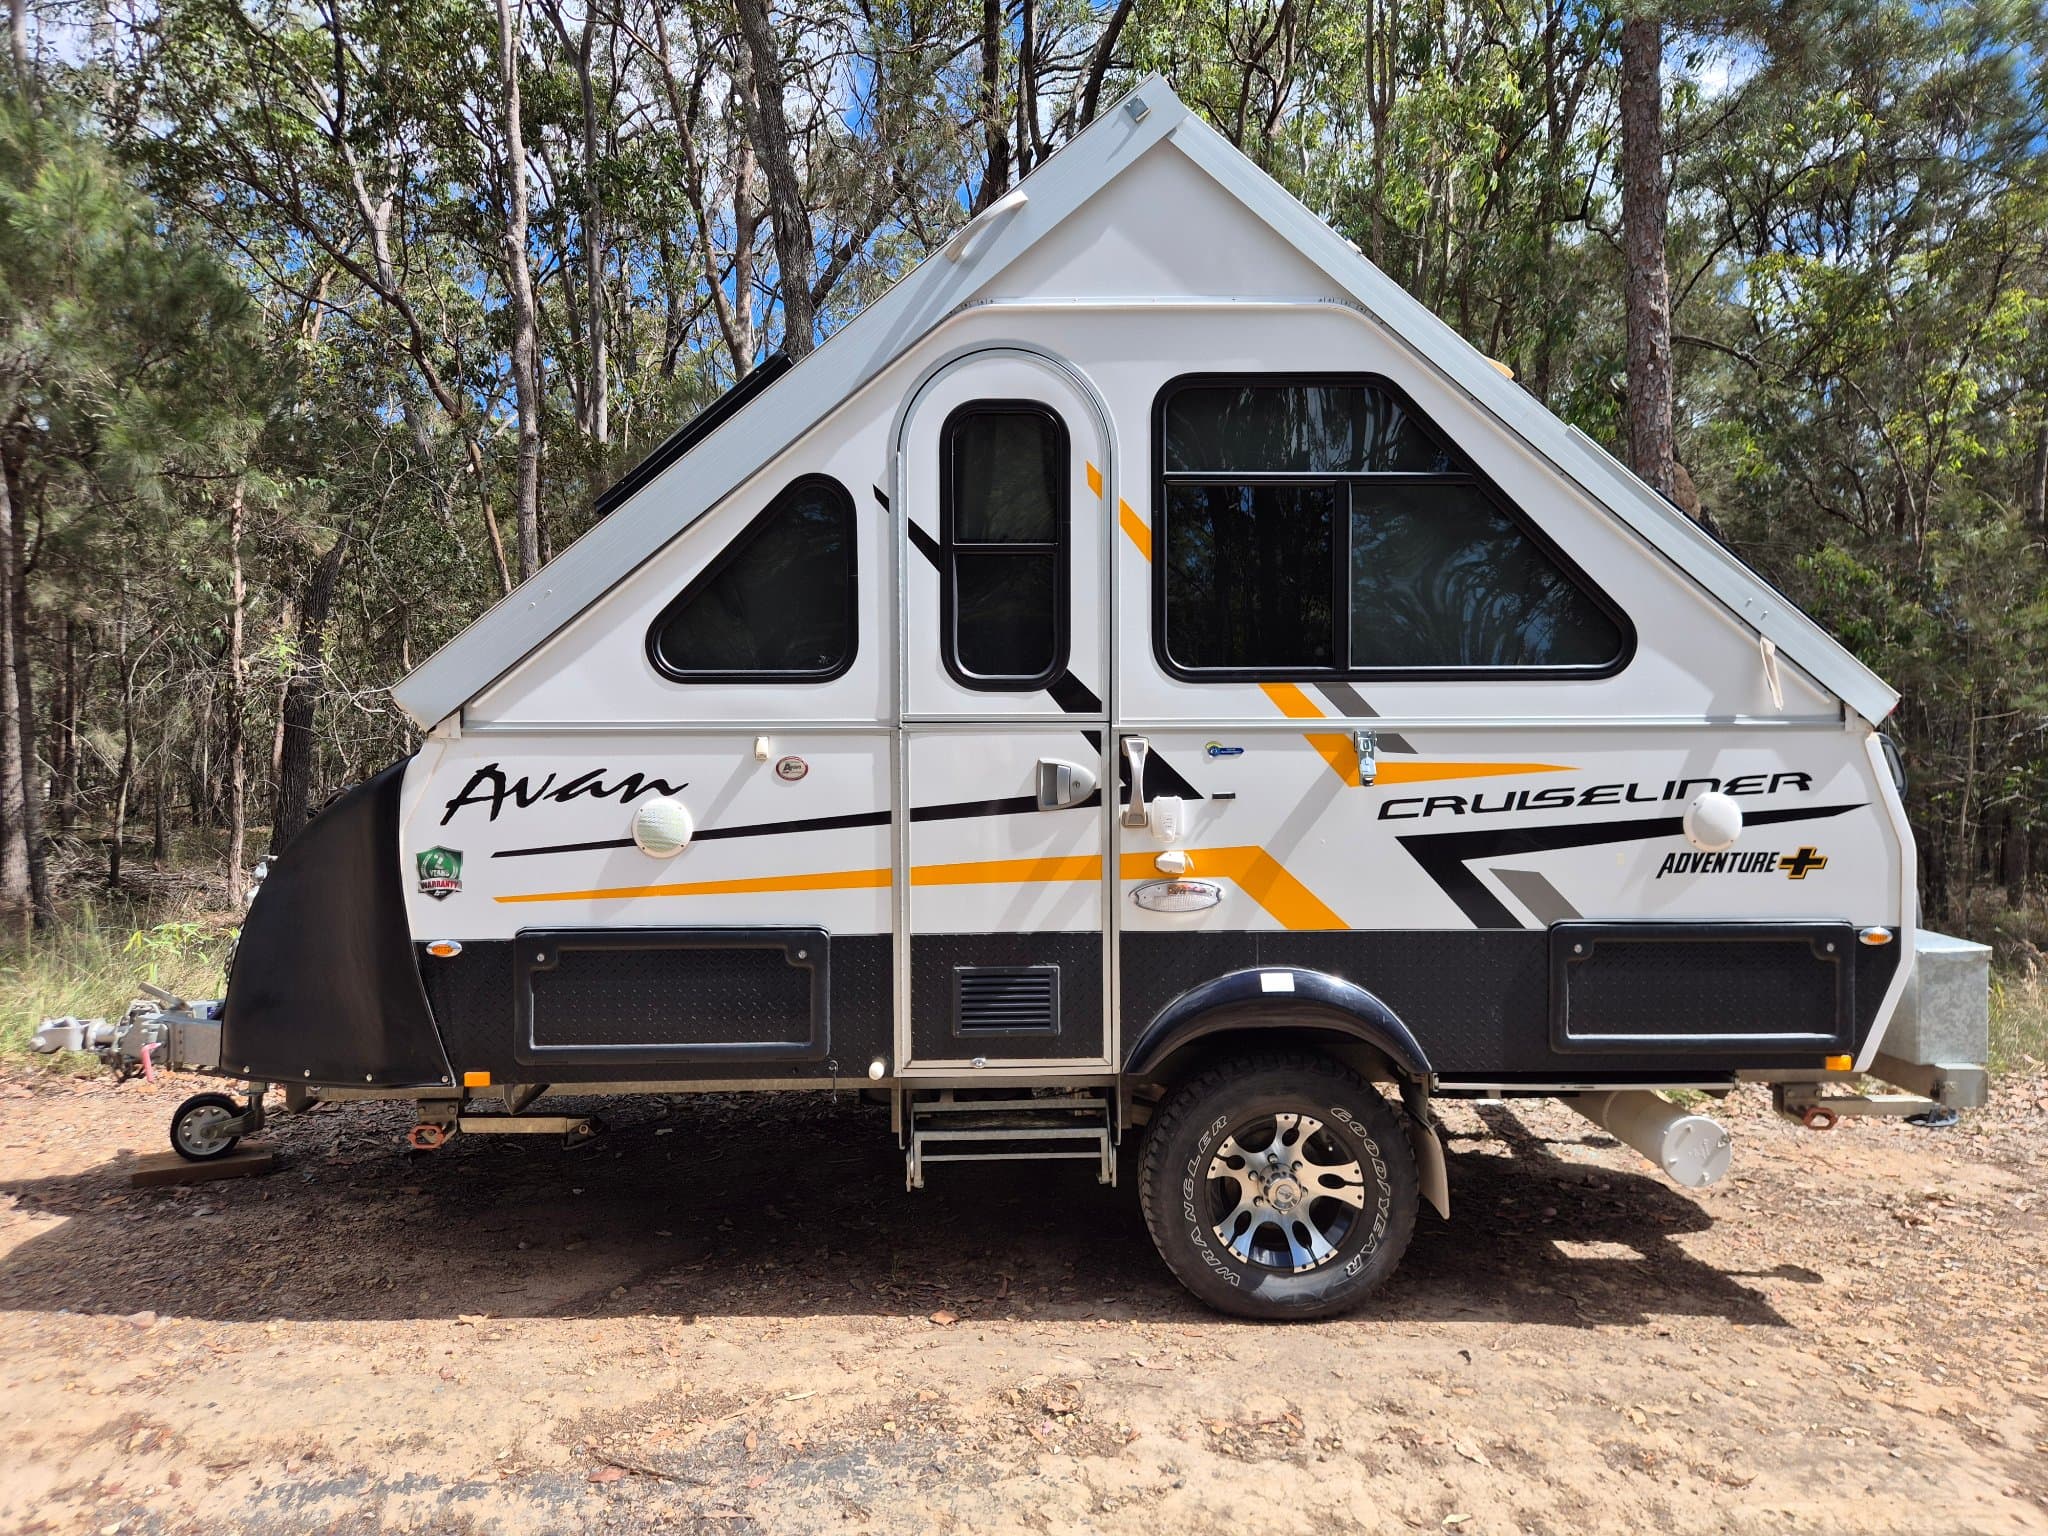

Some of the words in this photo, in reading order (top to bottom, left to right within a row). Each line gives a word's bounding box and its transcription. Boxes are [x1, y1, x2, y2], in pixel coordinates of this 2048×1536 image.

[440, 763, 689, 826] Avan
[1377, 772, 1813, 820] CRUISELINER
[420, 880, 459, 889] WARRANTY
[1183, 1115, 1241, 1287] WRANGLER
[1331, 1107, 1391, 1278] GOODYEAR
